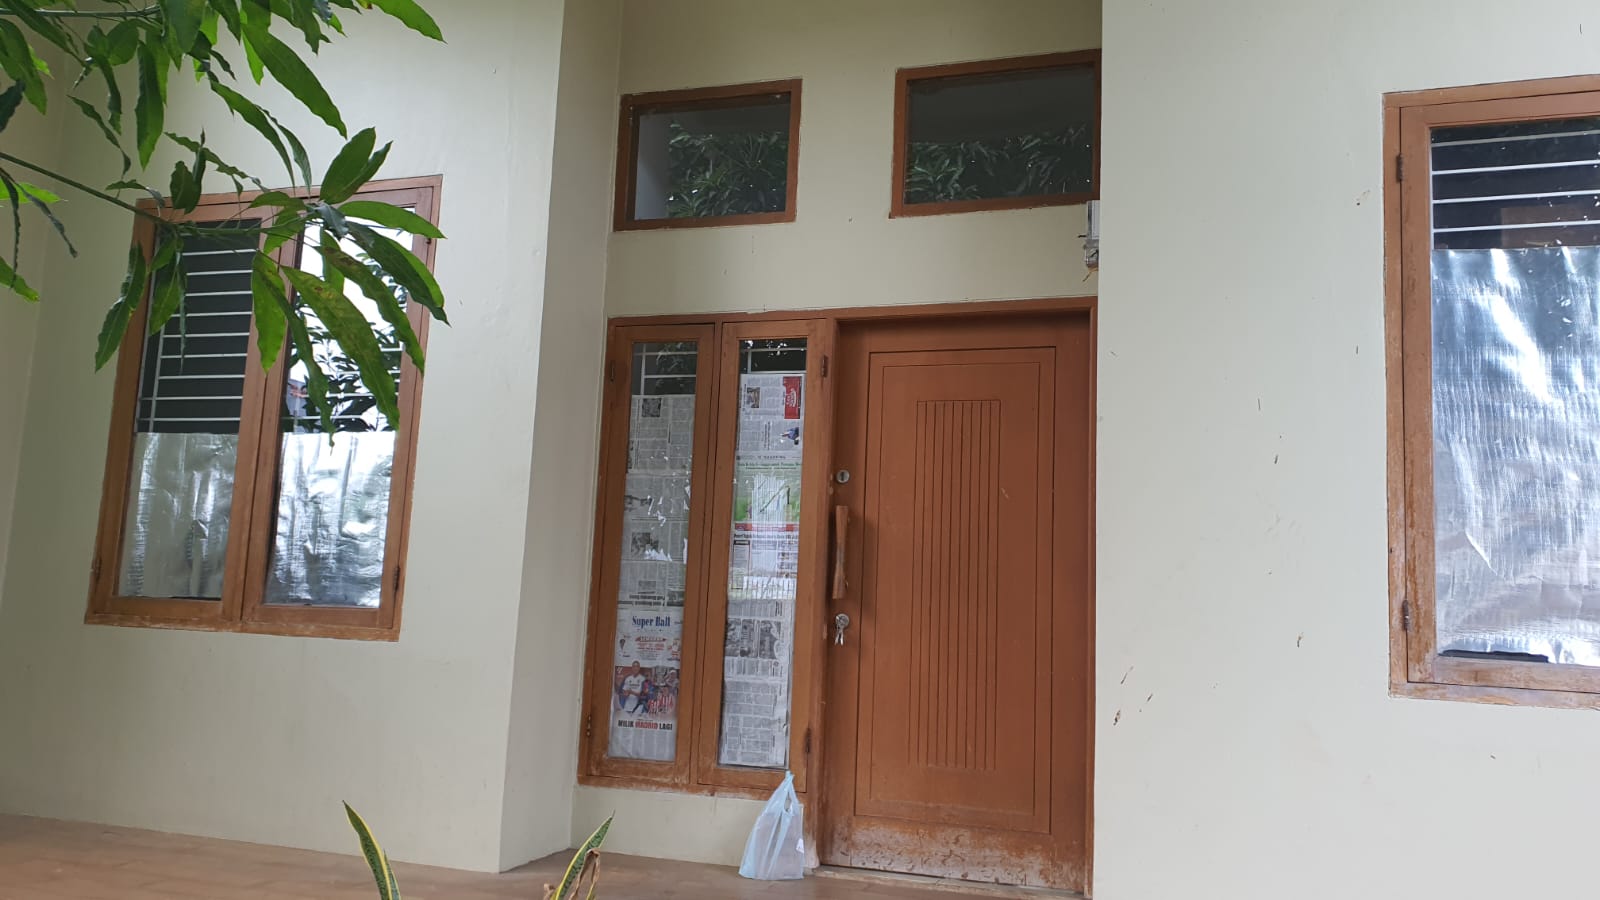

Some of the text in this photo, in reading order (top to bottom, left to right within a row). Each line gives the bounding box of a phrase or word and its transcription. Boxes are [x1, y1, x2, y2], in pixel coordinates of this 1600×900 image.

[632, 616, 671, 629] Super Ball
[618, 719, 673, 731] MILIK MADRID LAGI
